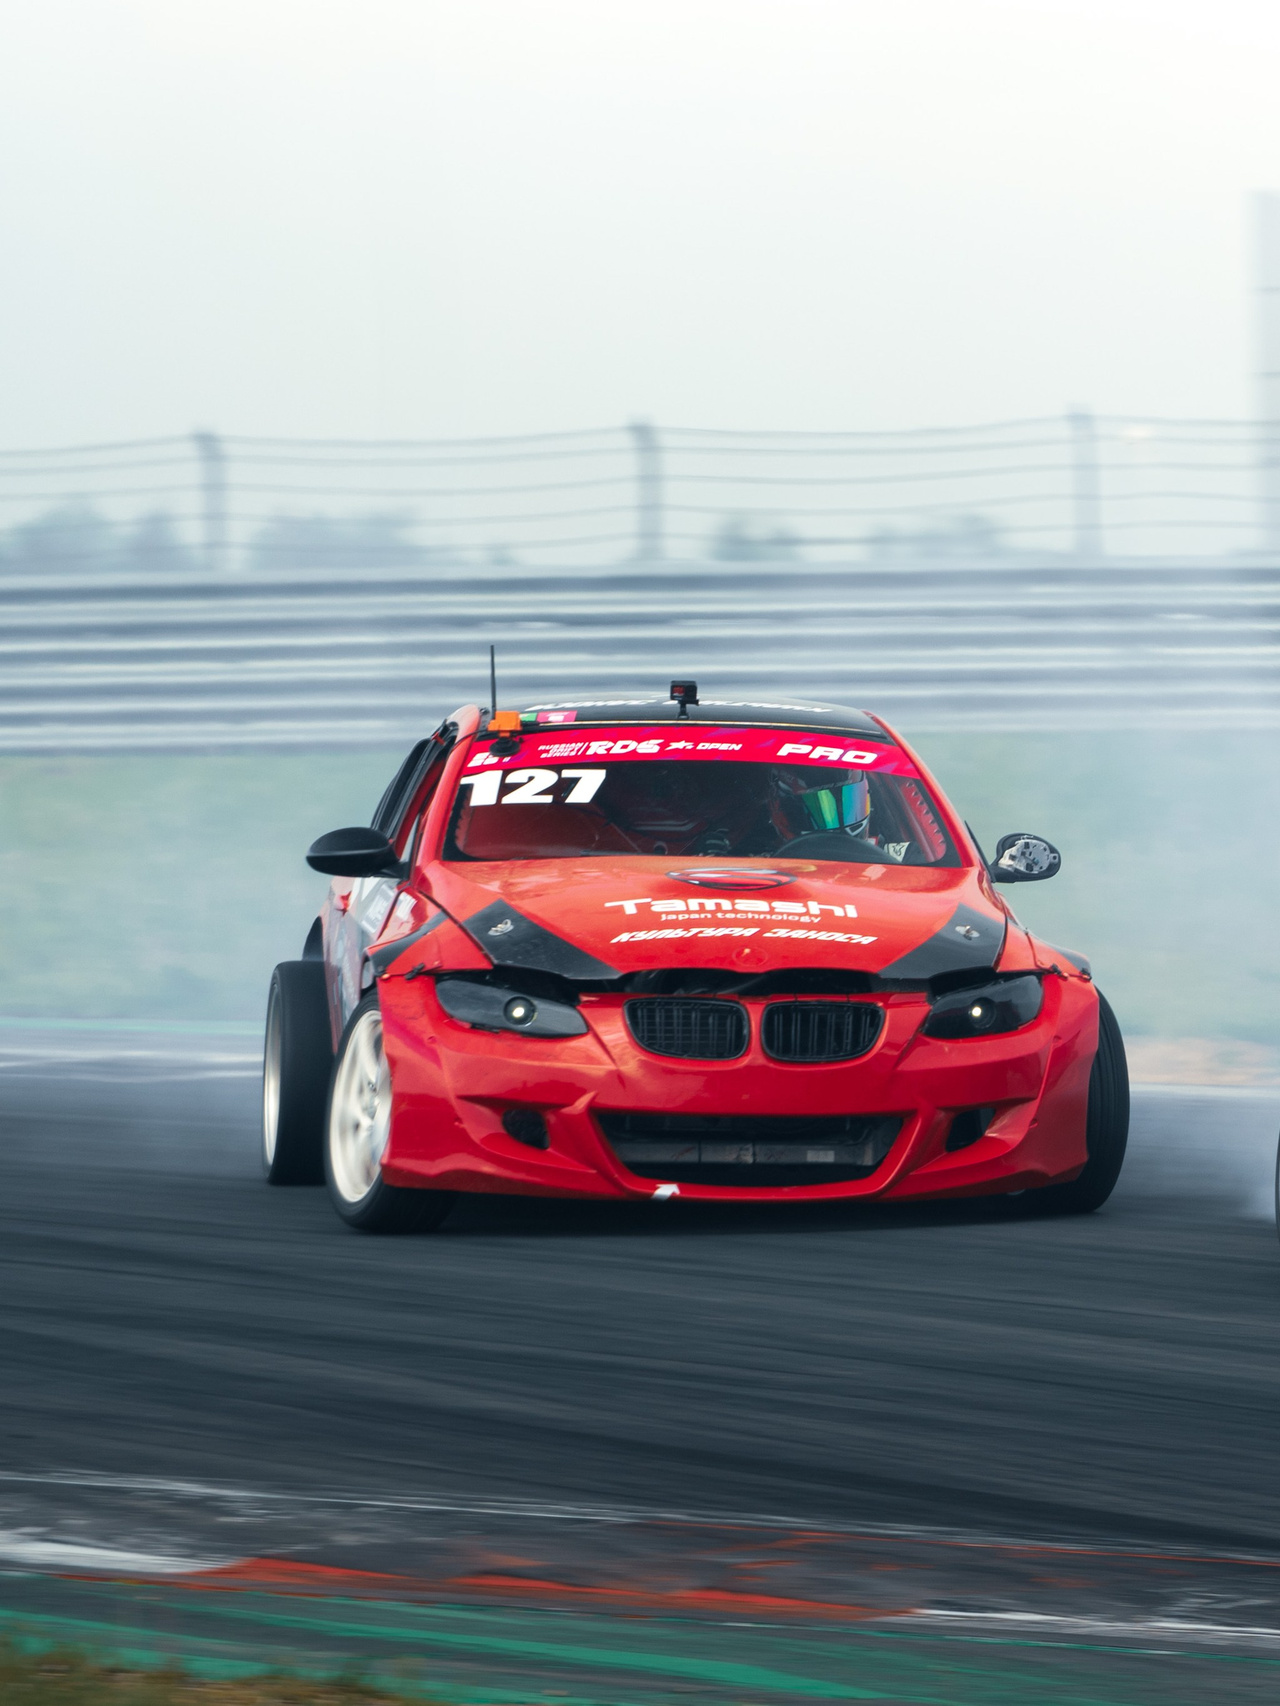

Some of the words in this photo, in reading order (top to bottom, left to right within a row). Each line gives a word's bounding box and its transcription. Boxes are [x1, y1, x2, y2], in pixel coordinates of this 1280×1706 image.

[695, 742, 742, 751] OPEN
[776, 743, 878, 764] PRO
[460, 768, 607, 807] 127
[603, 897, 859, 919] Tamashi
[660, 912, 713, 922] japan
[716, 912, 822, 924] technology
[610, 927, 761, 944] КУЛЬТУРА
[763, 928, 878, 945] ЗАНОСА
